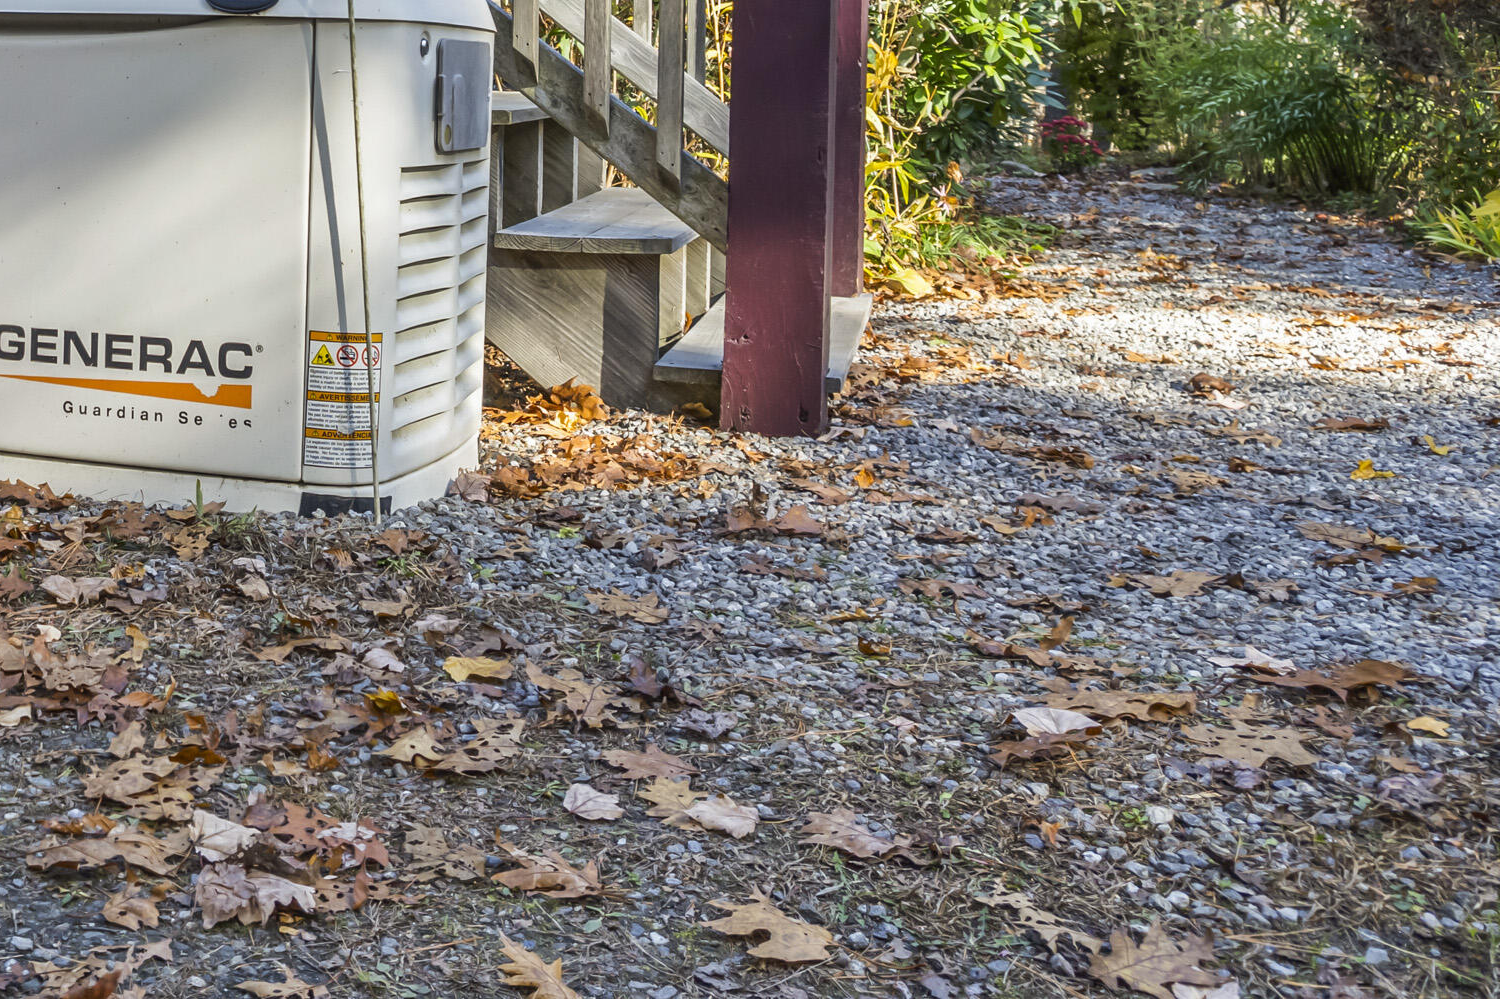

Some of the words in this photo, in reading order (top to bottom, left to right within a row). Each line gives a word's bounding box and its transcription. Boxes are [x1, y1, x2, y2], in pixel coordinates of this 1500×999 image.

[319, 394, 377, 402] AVERTISSEMET
[63, 401, 163, 422] Guardian
[178, 411, 252, 428] Sees
